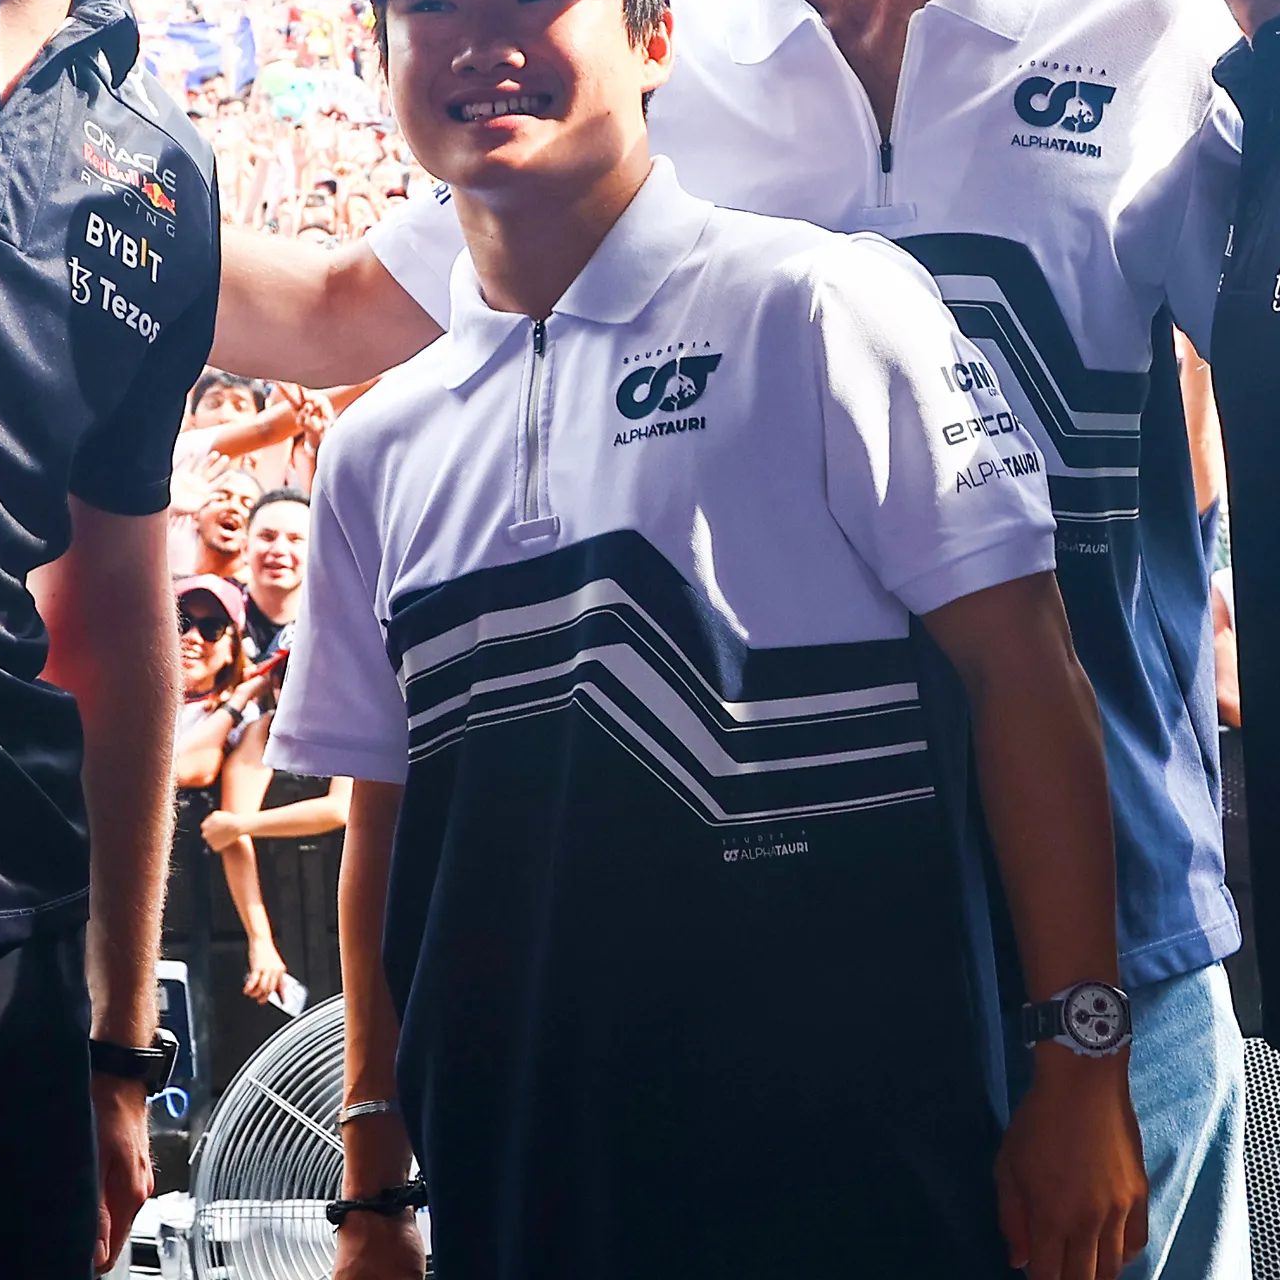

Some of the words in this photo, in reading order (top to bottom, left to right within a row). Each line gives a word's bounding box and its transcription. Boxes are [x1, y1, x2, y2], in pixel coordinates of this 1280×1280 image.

[84, 121, 177, 192] ORACLE
[1011, 134, 1103, 159] ALPHATAURI
[81, 170, 175, 238] RACING
[85, 212, 163, 283] BYBIT
[99, 276, 162, 344] Tezos
[623, 341, 710, 365] SCUDERIA
[613, 417, 705, 446] ALPHATAURI
